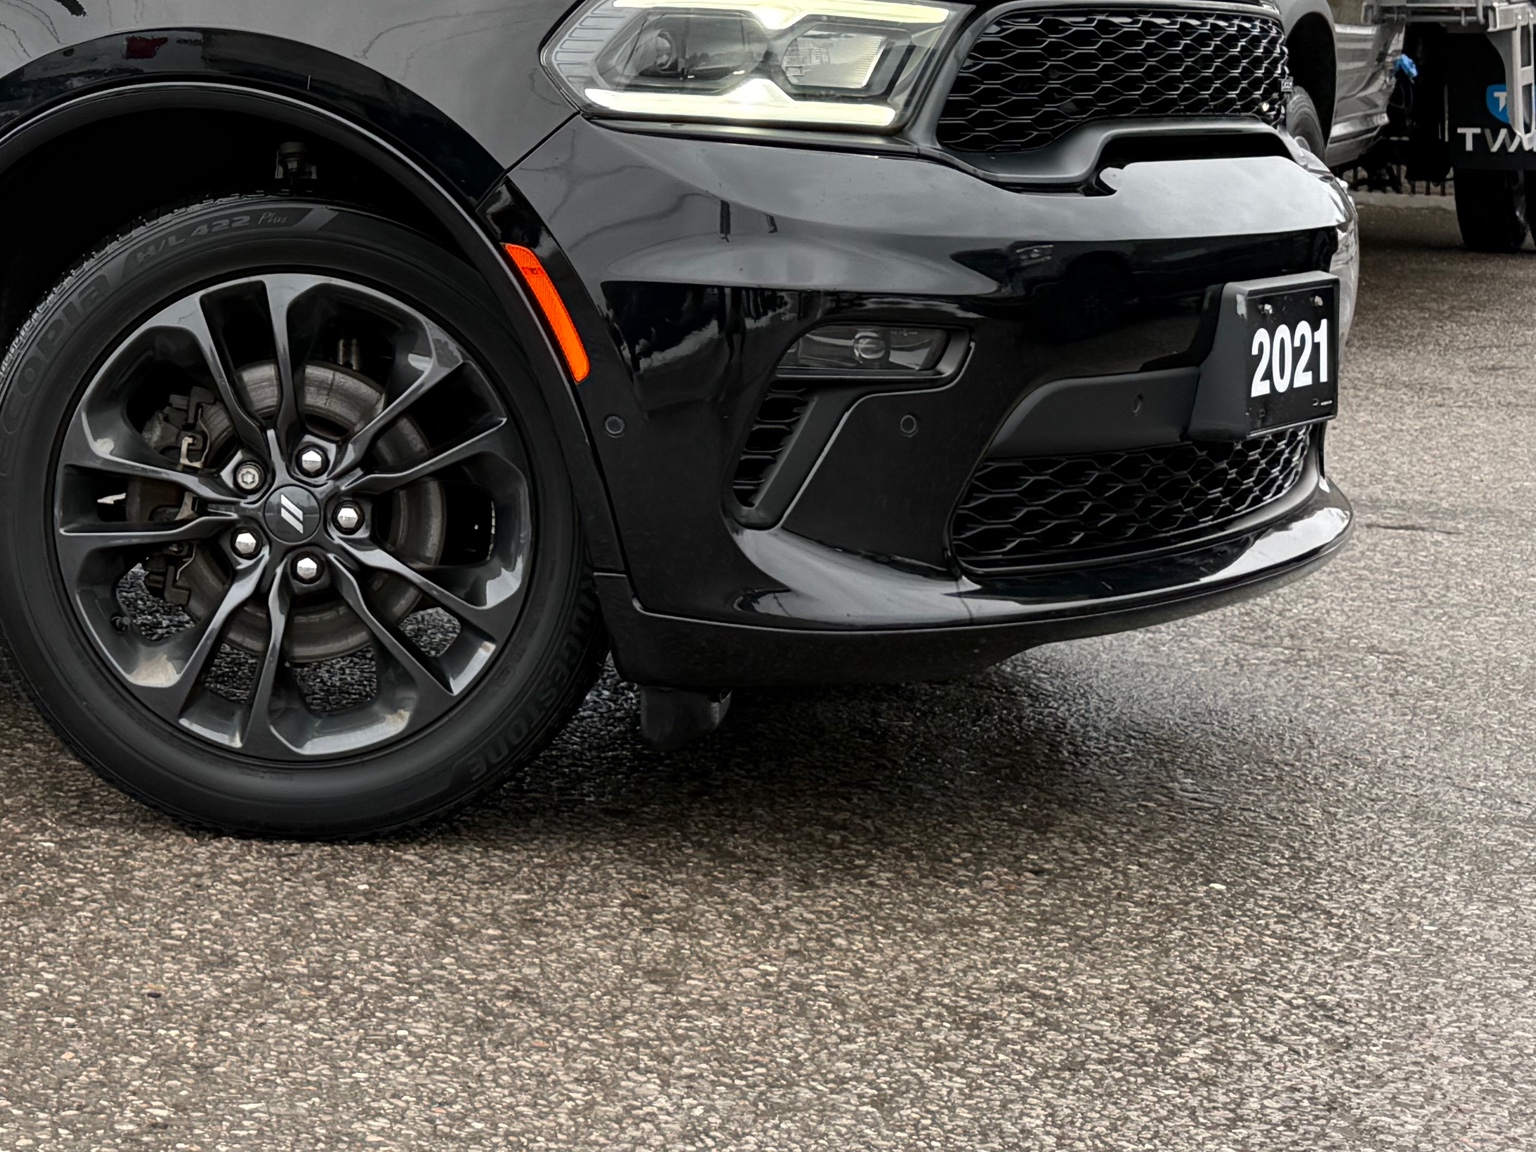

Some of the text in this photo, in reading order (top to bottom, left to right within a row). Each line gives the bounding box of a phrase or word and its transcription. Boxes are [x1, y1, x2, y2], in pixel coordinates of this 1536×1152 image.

[1457, 127, 1536, 152] TW
[190, 214, 251, 238] 422
[1250, 318, 1328, 398] 2021
